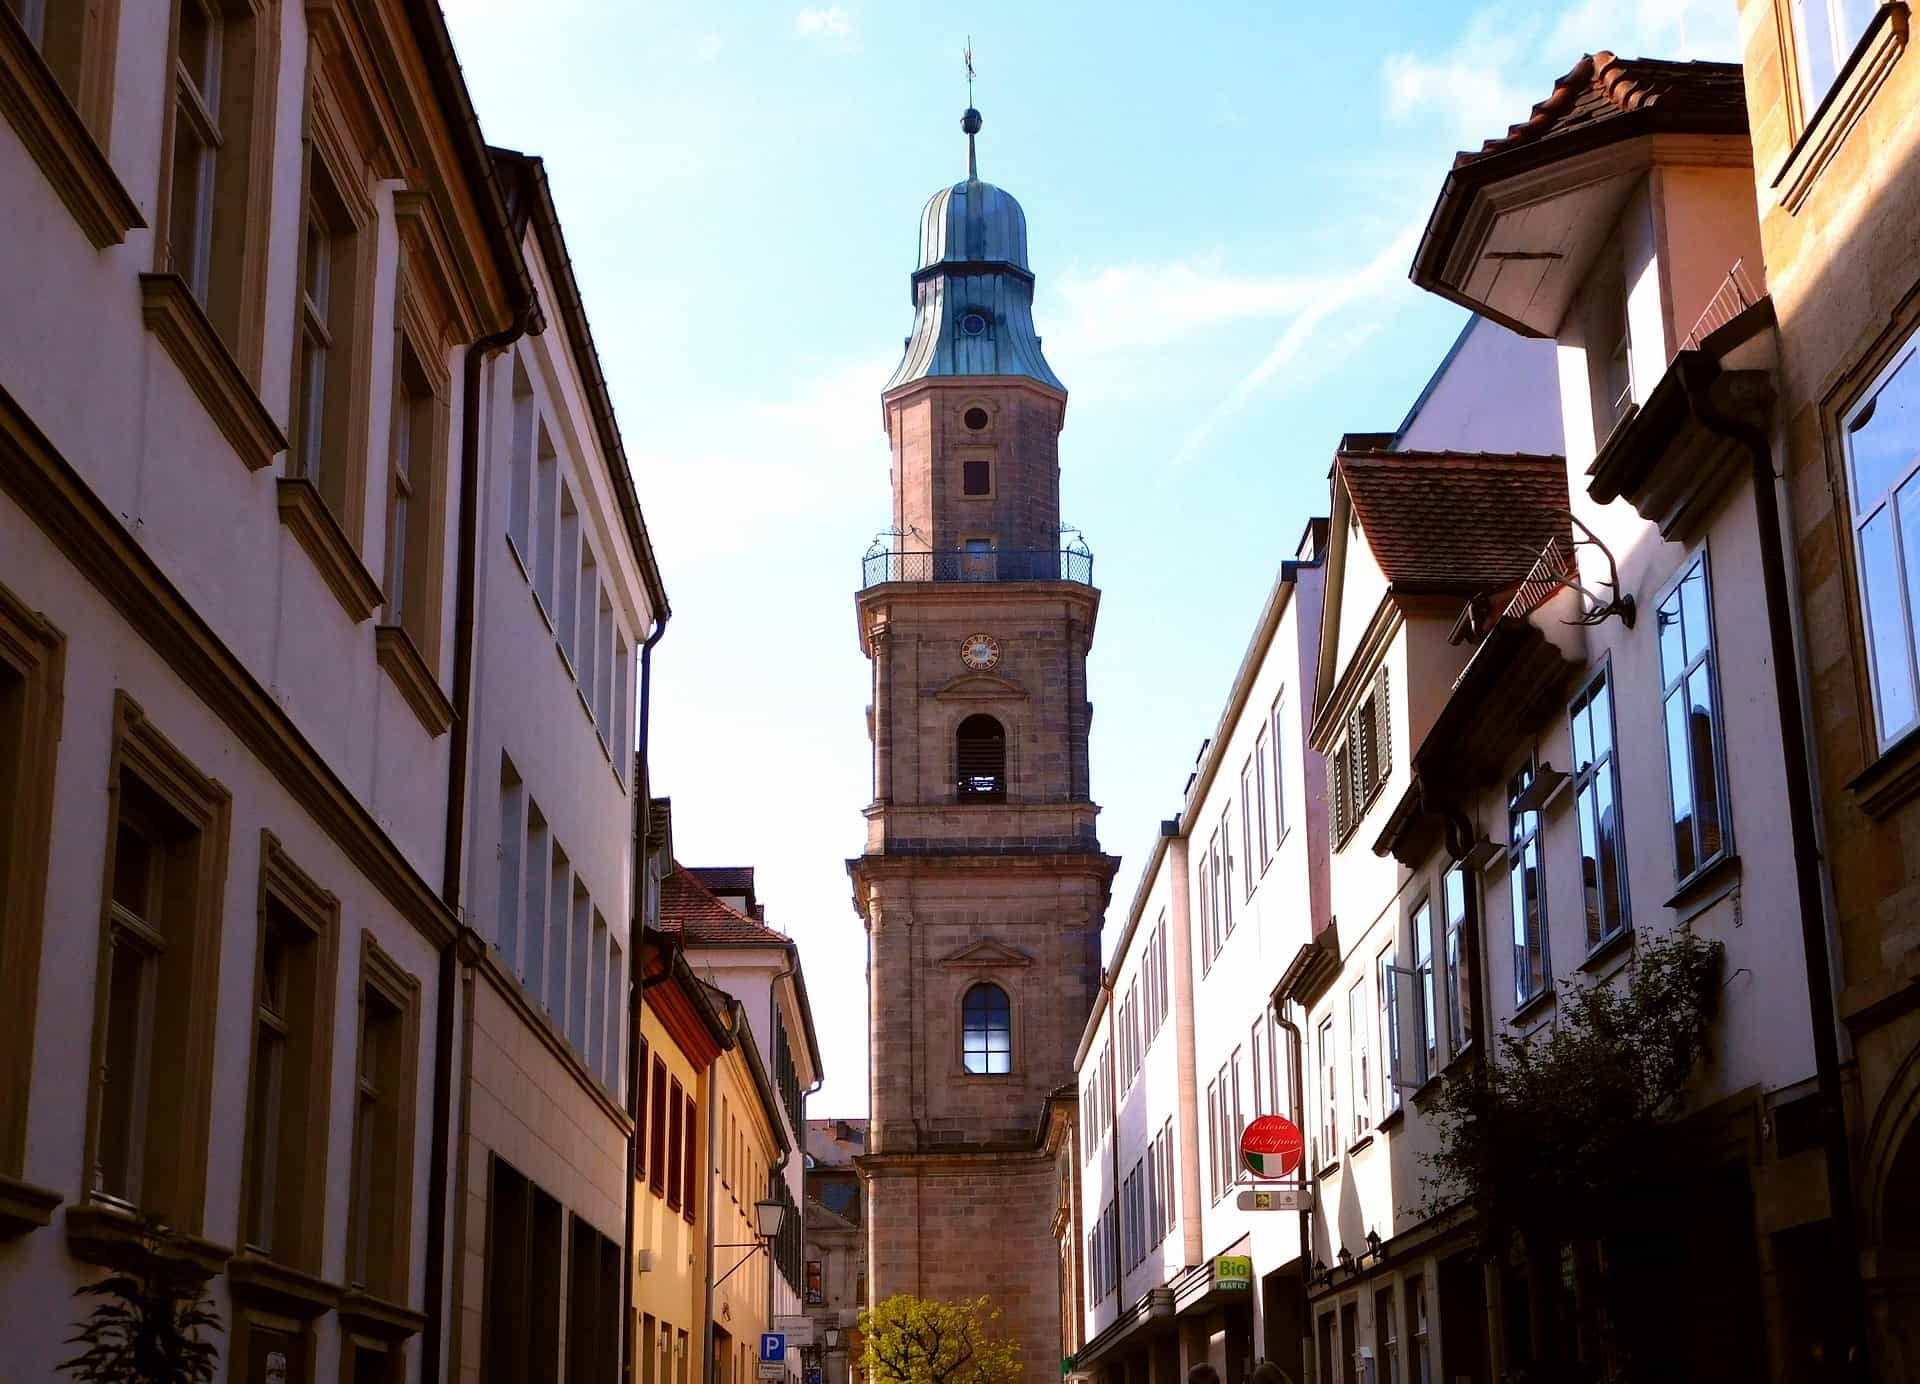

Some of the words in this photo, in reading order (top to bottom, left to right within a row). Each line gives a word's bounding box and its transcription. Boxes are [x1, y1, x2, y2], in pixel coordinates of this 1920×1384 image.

[1220, 1261, 1246, 1276] Bio
[1220, 1281, 1246, 1289] MARKT
[766, 1336, 779, 1358] P
